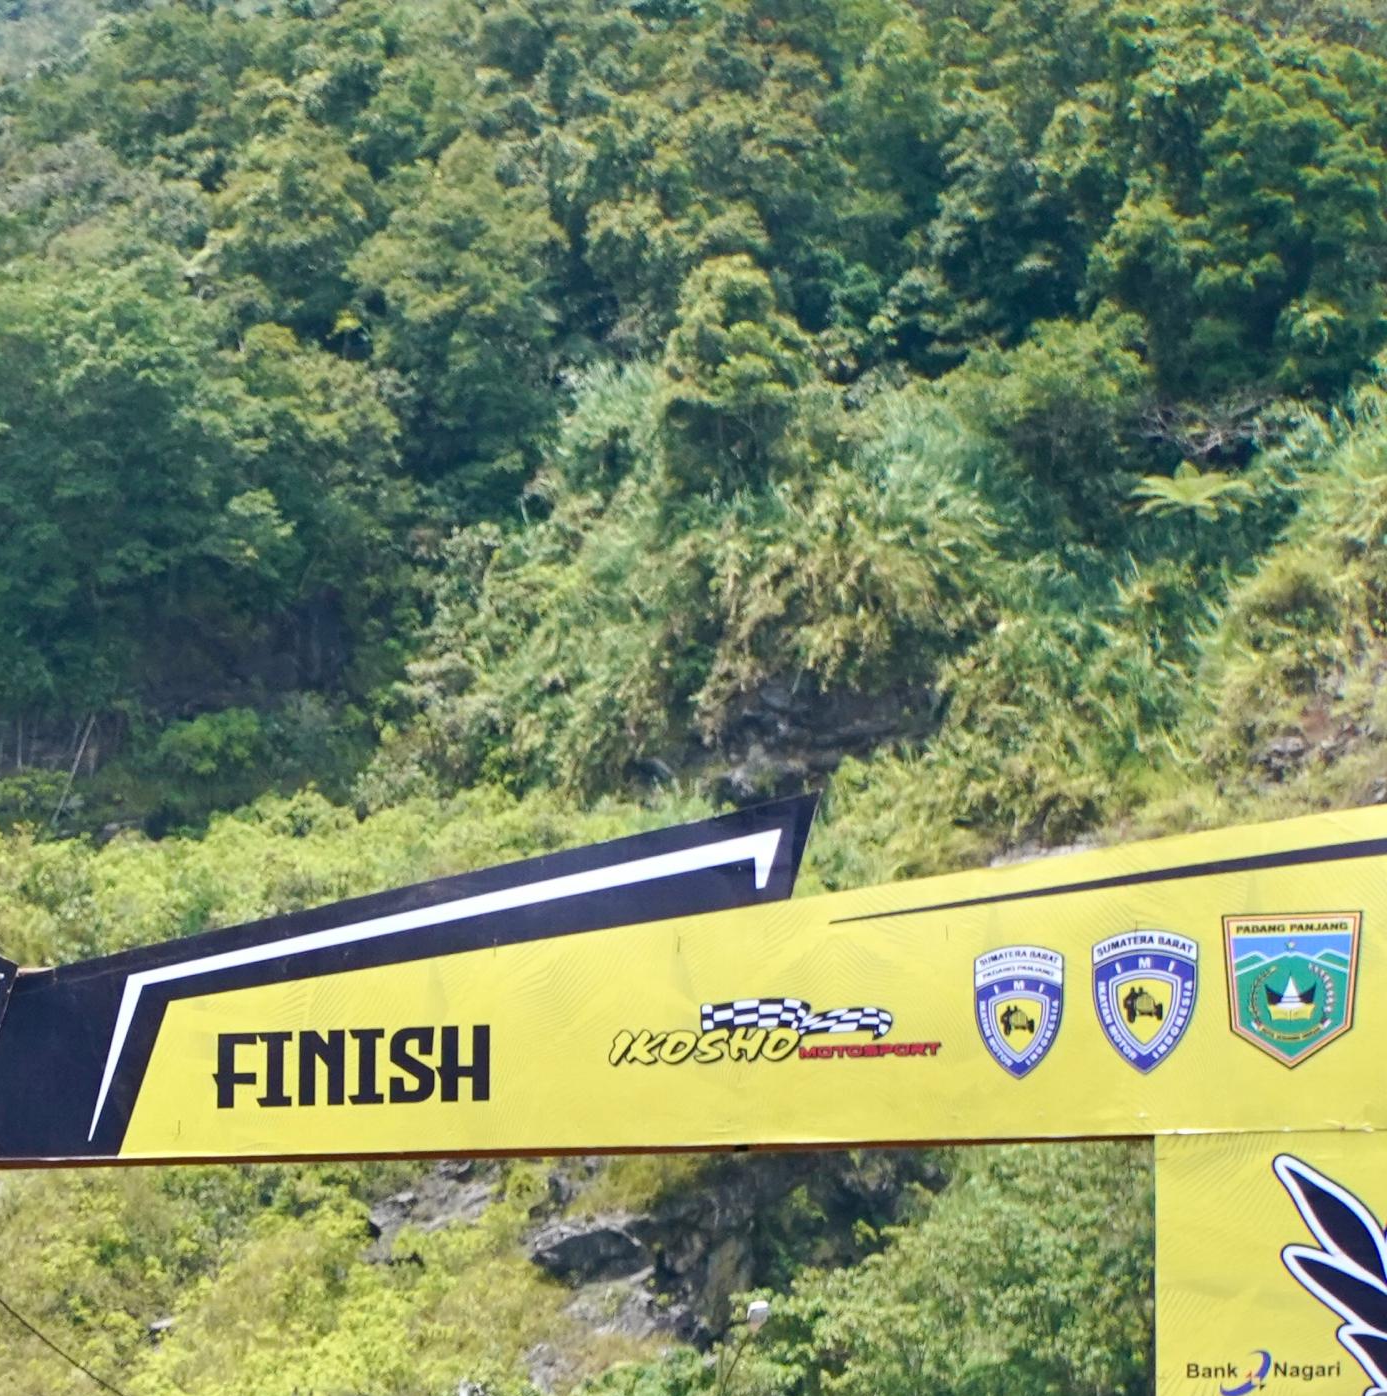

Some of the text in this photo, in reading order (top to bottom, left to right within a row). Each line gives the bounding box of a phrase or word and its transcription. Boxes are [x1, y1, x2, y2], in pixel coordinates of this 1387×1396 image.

[1236, 921, 1348, 935] PADANG PANJANG
[1096, 935, 1194, 957] SUMATERA BARAT
[608, 1026, 941, 1067] IKOSHO MOTOSPORT
[213, 1024, 491, 1109] FINISH
[1186, 1360, 1342, 1381] Bank Nagari
